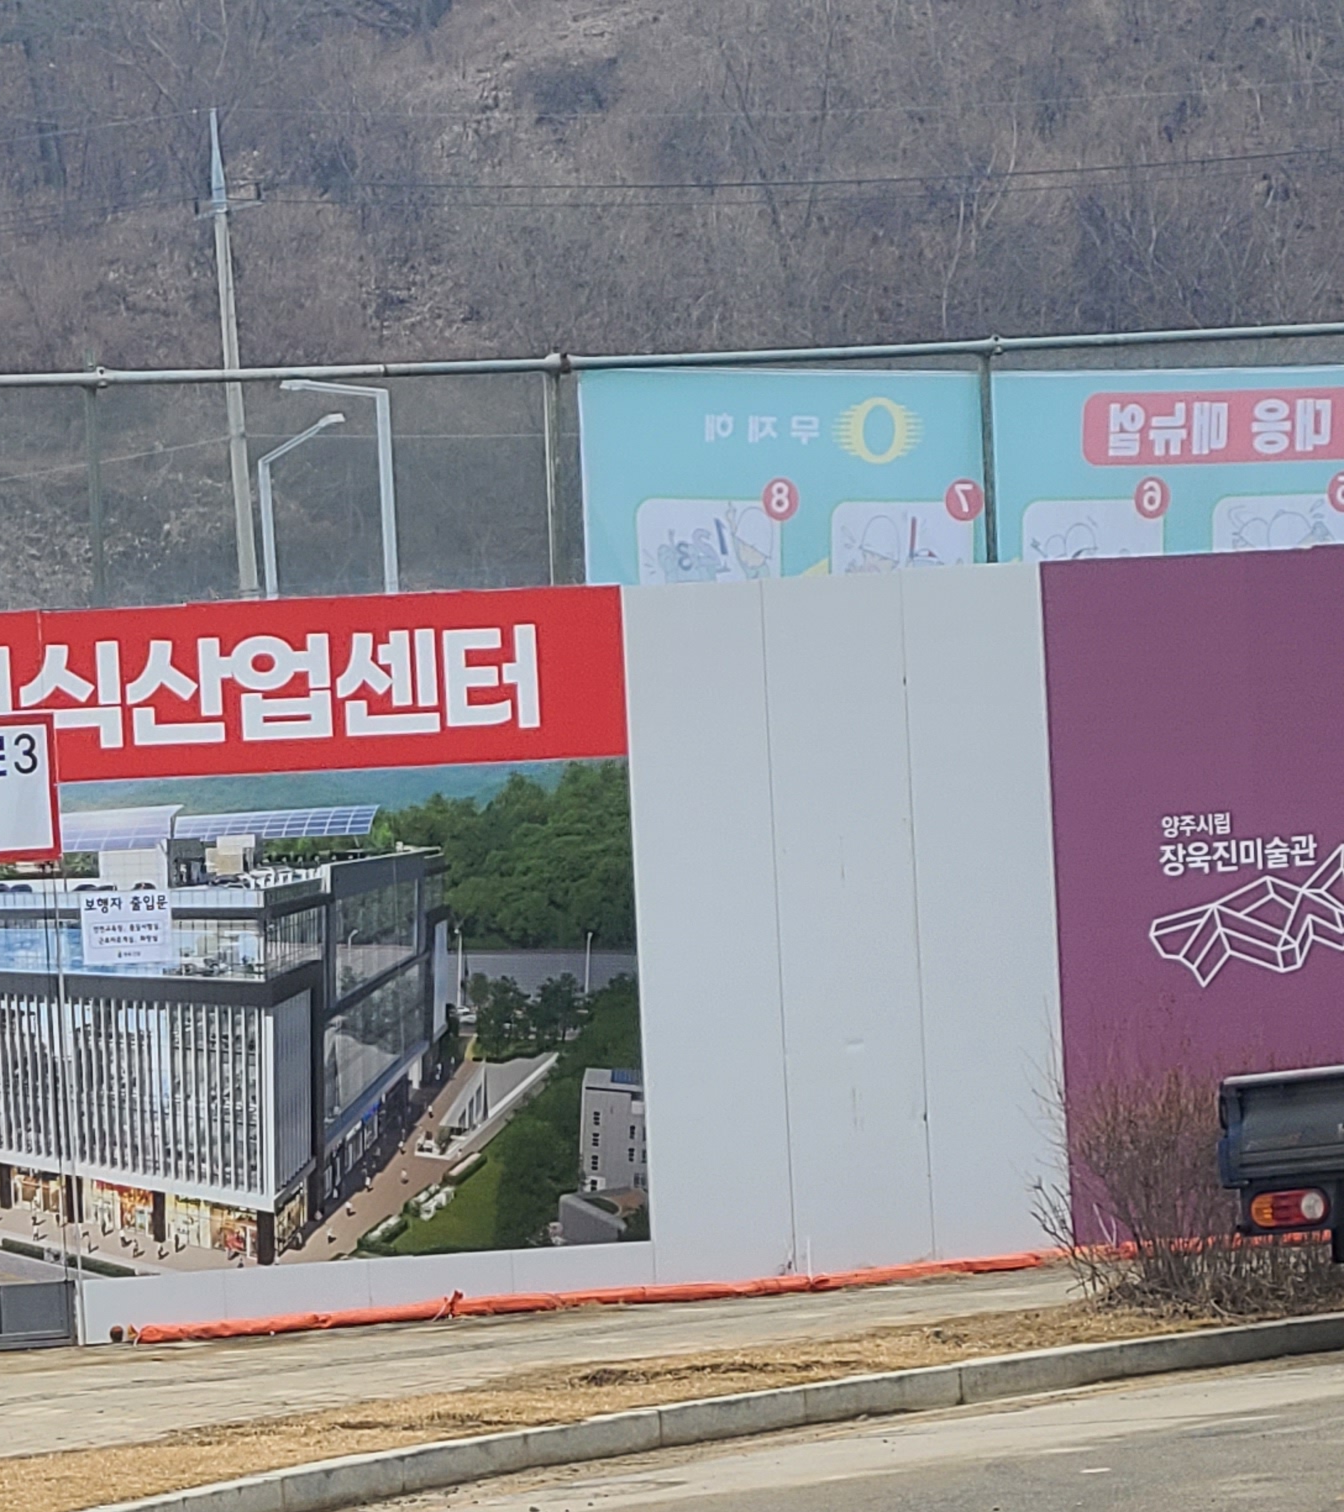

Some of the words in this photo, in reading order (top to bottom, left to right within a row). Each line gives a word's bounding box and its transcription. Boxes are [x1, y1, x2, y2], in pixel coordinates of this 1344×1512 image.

[14, 733, 38, 775] 3
[1161, 812, 1232, 838] 양주시립
[1159, 834, 1318, 877] 장욱진미술관
[84, 897, 123, 913] 보행자
[130, 895, 169, 911] 출입문
